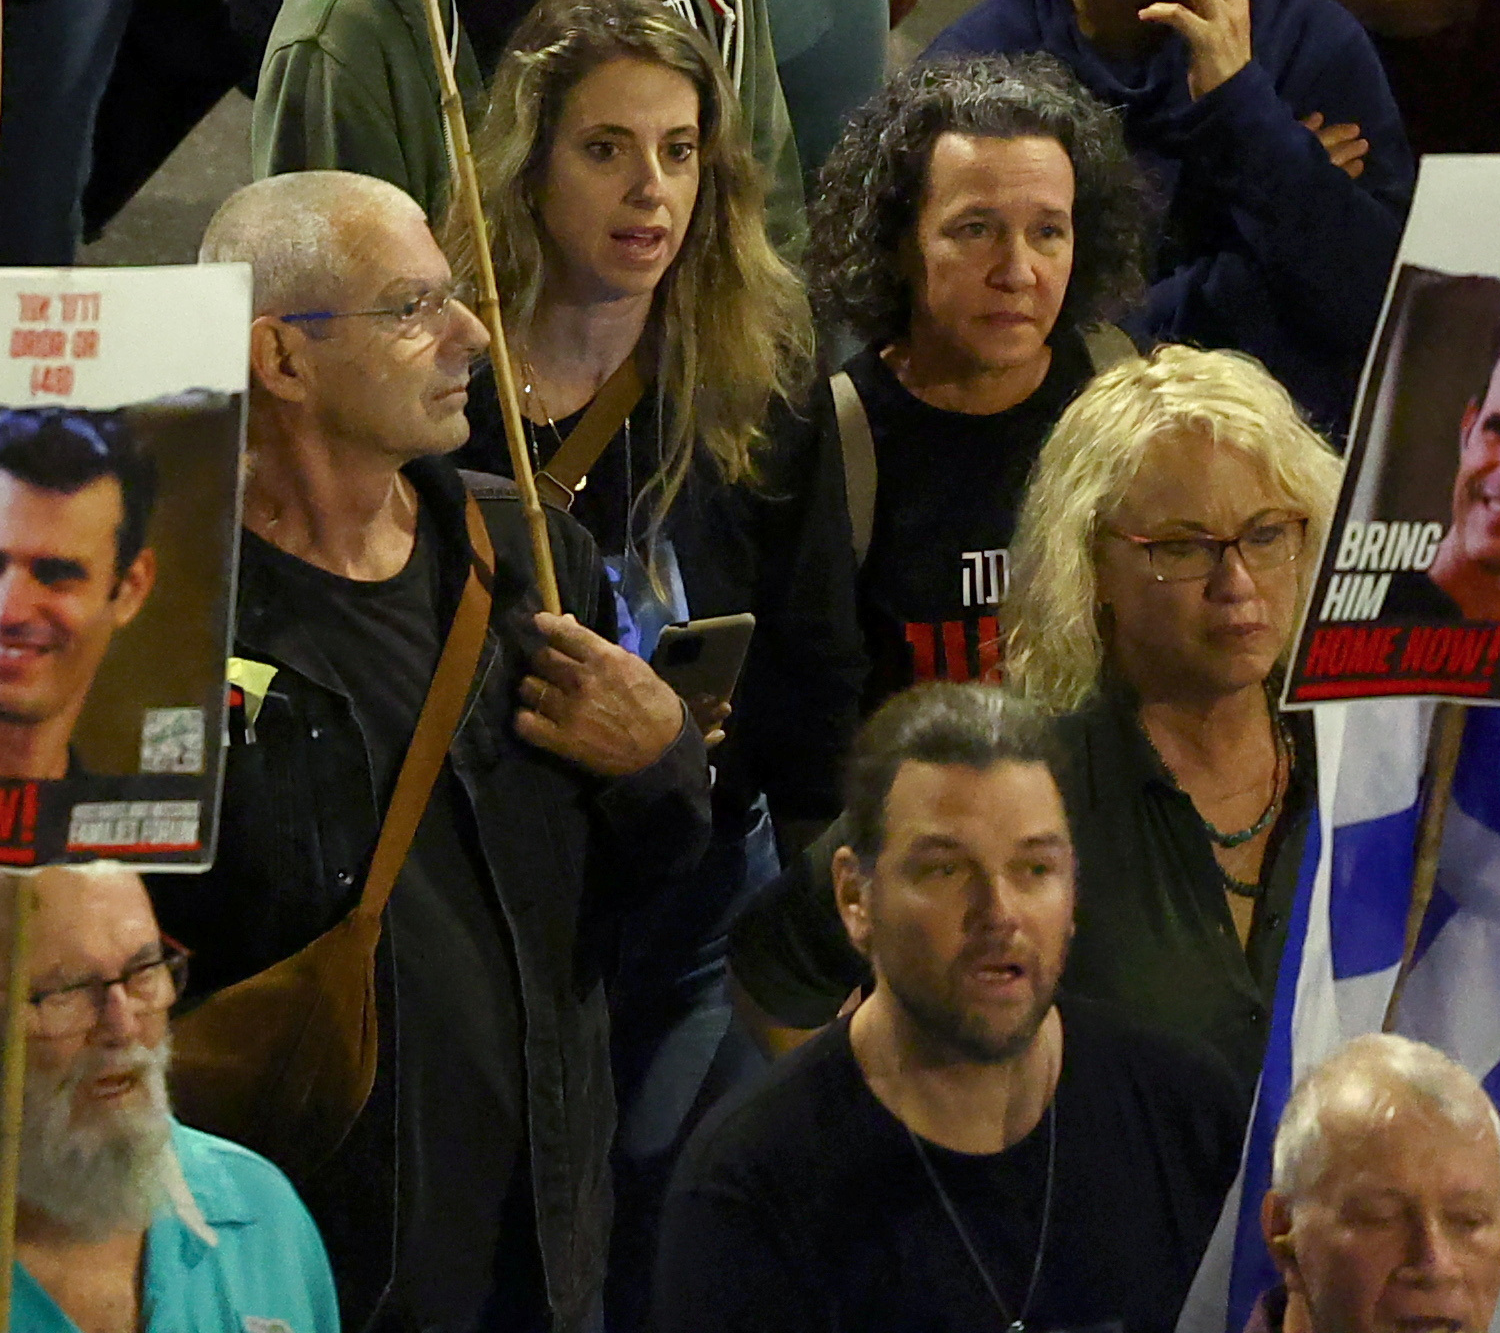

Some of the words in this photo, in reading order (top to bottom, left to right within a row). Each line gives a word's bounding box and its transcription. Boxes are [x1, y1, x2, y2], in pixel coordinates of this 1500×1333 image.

[1334, 520, 1443, 571] BRING
[1318, 571, 1393, 622] HIM
[1303, 626, 1402, 676] HOME
